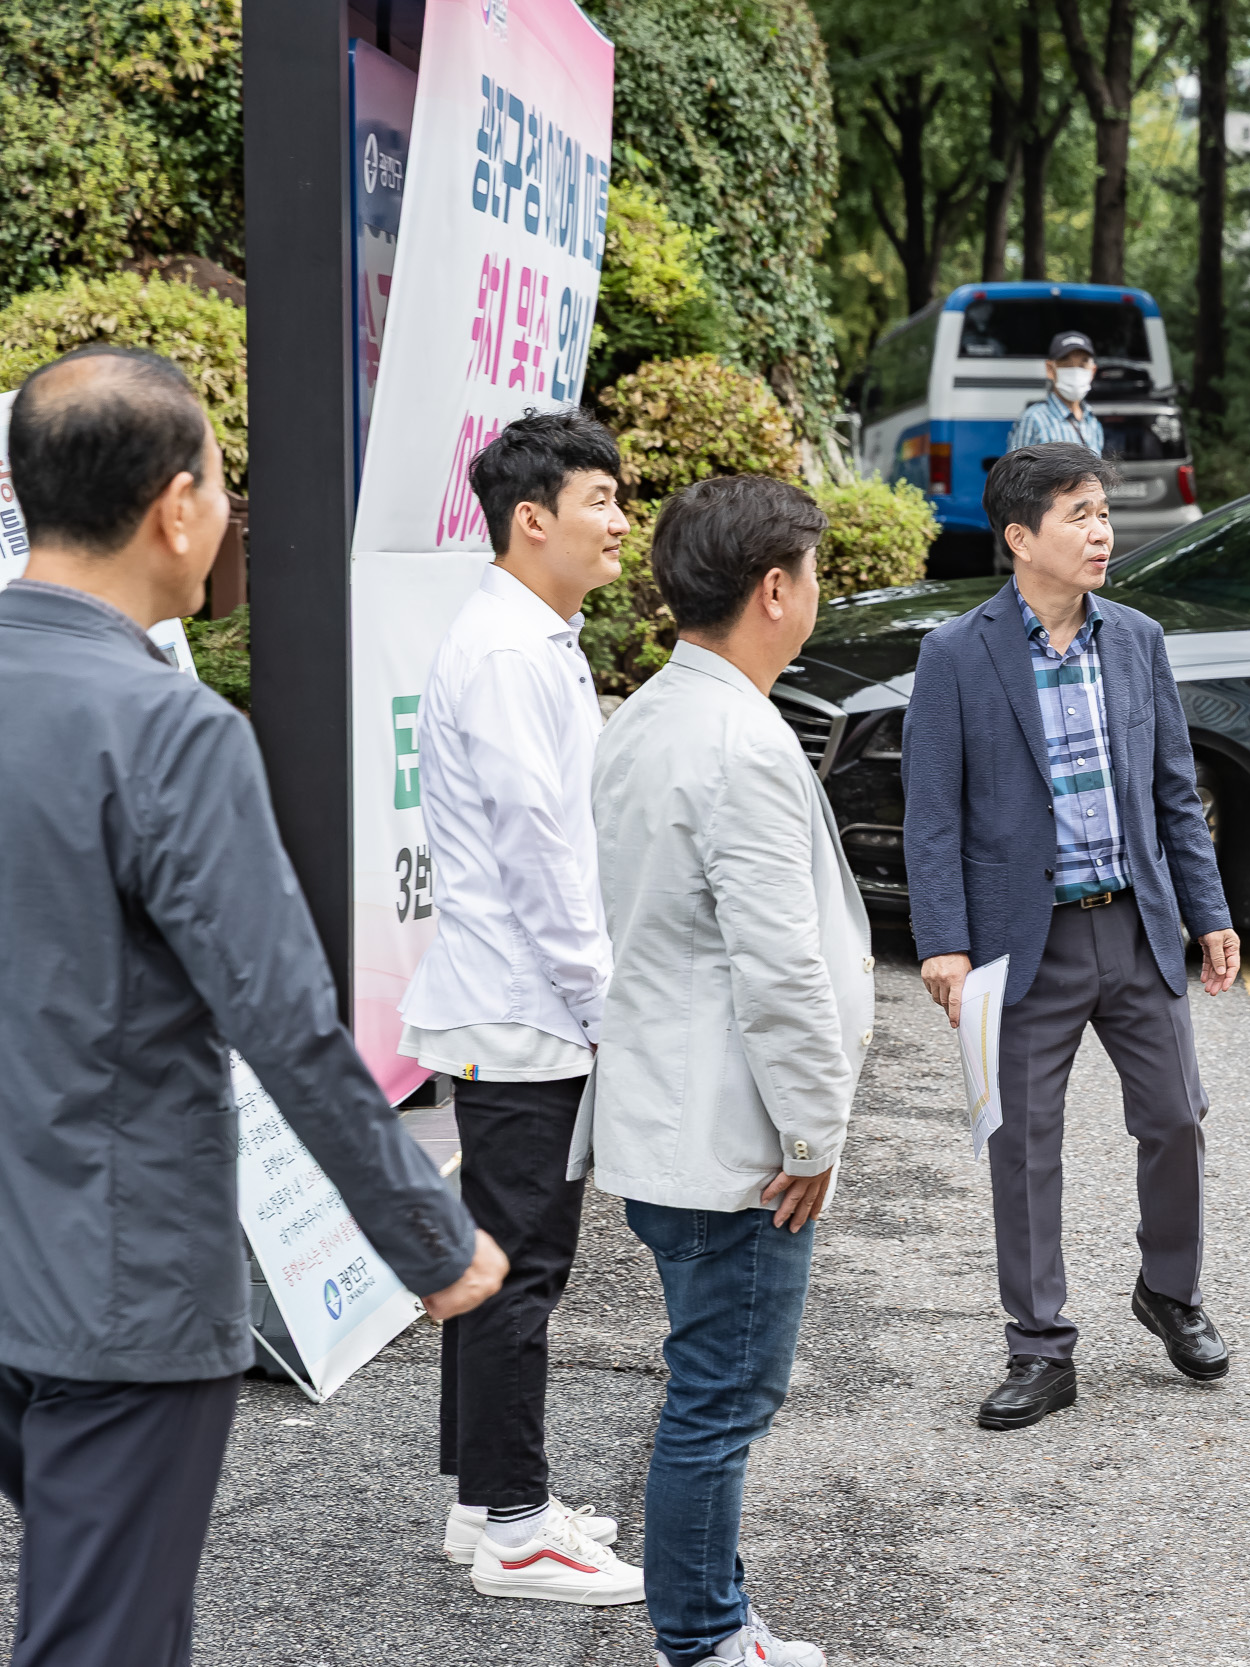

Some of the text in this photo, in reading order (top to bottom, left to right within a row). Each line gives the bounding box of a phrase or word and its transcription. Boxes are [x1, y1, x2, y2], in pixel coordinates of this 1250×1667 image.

[379, 151, 403, 191] 광진구
[472, 73, 542, 236] 광진구청
[466, 252, 510, 385] 위치
[508, 266, 537, 393] 및
[395, 844, 433, 923] 3번
[337, 1256, 368, 1292] 광진구
